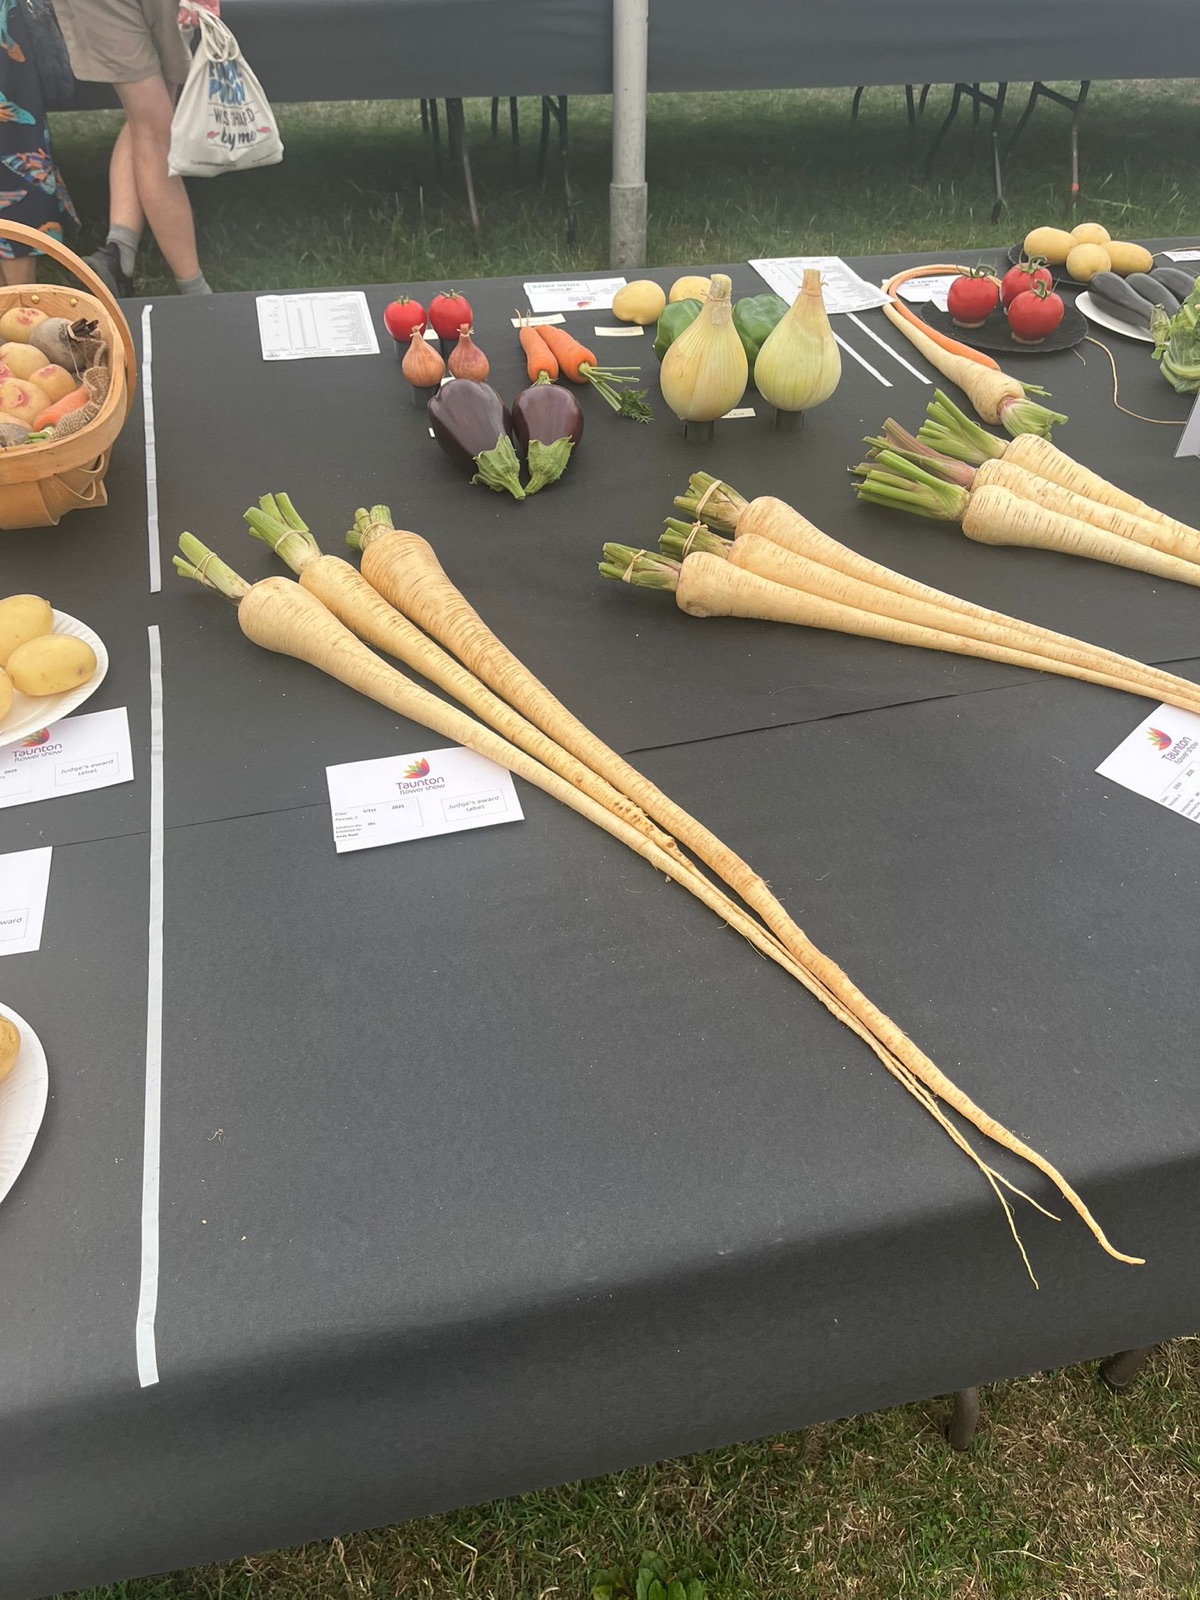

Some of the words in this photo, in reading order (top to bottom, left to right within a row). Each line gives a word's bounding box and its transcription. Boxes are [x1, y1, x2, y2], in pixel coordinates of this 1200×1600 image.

[12, 743, 63, 757] Taunton
[1161, 736, 1192, 761] Taunton
[90, 759, 114, 768] award
[395, 776, 445, 790] Taunton
[399, 787, 424, 795] flower
[424, 783, 446, 791] show
[448, 800, 476, 809] Judge's
[477, 795, 500, 804] award
[465, 804, 486, 812] label
